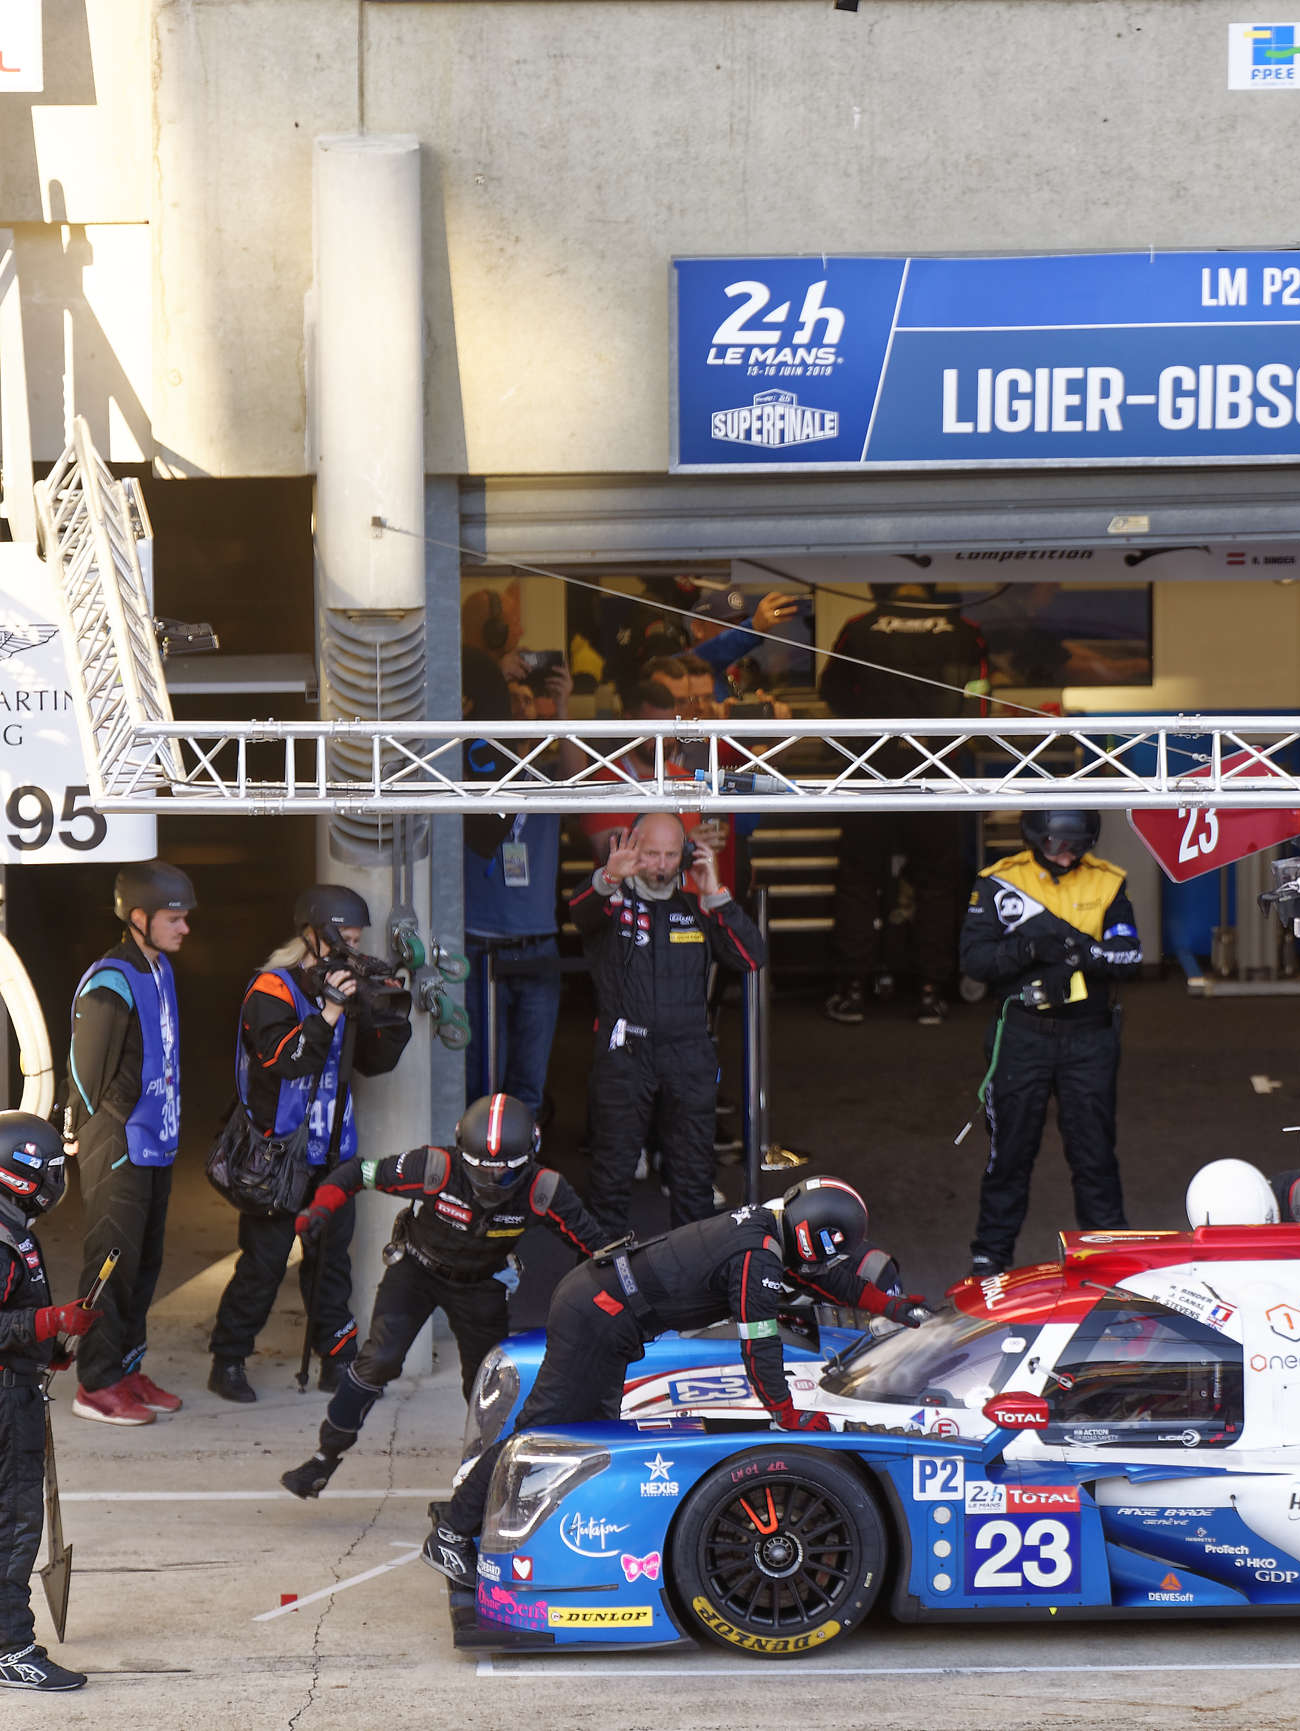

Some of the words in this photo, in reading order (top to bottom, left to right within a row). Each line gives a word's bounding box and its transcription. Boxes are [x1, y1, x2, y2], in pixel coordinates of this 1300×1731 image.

[1201, 268, 1248, 306] LM
[712, 279, 845, 344] 24h
[707, 347, 745, 365] LE
[748, 347, 837, 365] MANS
[779, 366, 804, 376] JUIN
[713, 404, 836, 446] SUPERFINALE
[6, 785, 107, 851] 95
[1177, 807, 1219, 864] 23
[994, 1410, 1047, 1424] TOTAL
[919, 1459, 959, 1494] P2
[640, 1481, 680, 1495] HEXIS
[1009, 1489, 1077, 1504] TOTAL
[973, 1518, 1073, 1588] 23
[1204, 1543, 1250, 1555] ProTech
[1247, 1557, 1278, 1569] HKO
[1255, 1570, 1300, 1583] GDP
[1148, 1592, 1194, 1602] DEWESoft
[566, 1611, 648, 1622] DUNLOP
[699, 1606, 813, 1650] DUNLOP
